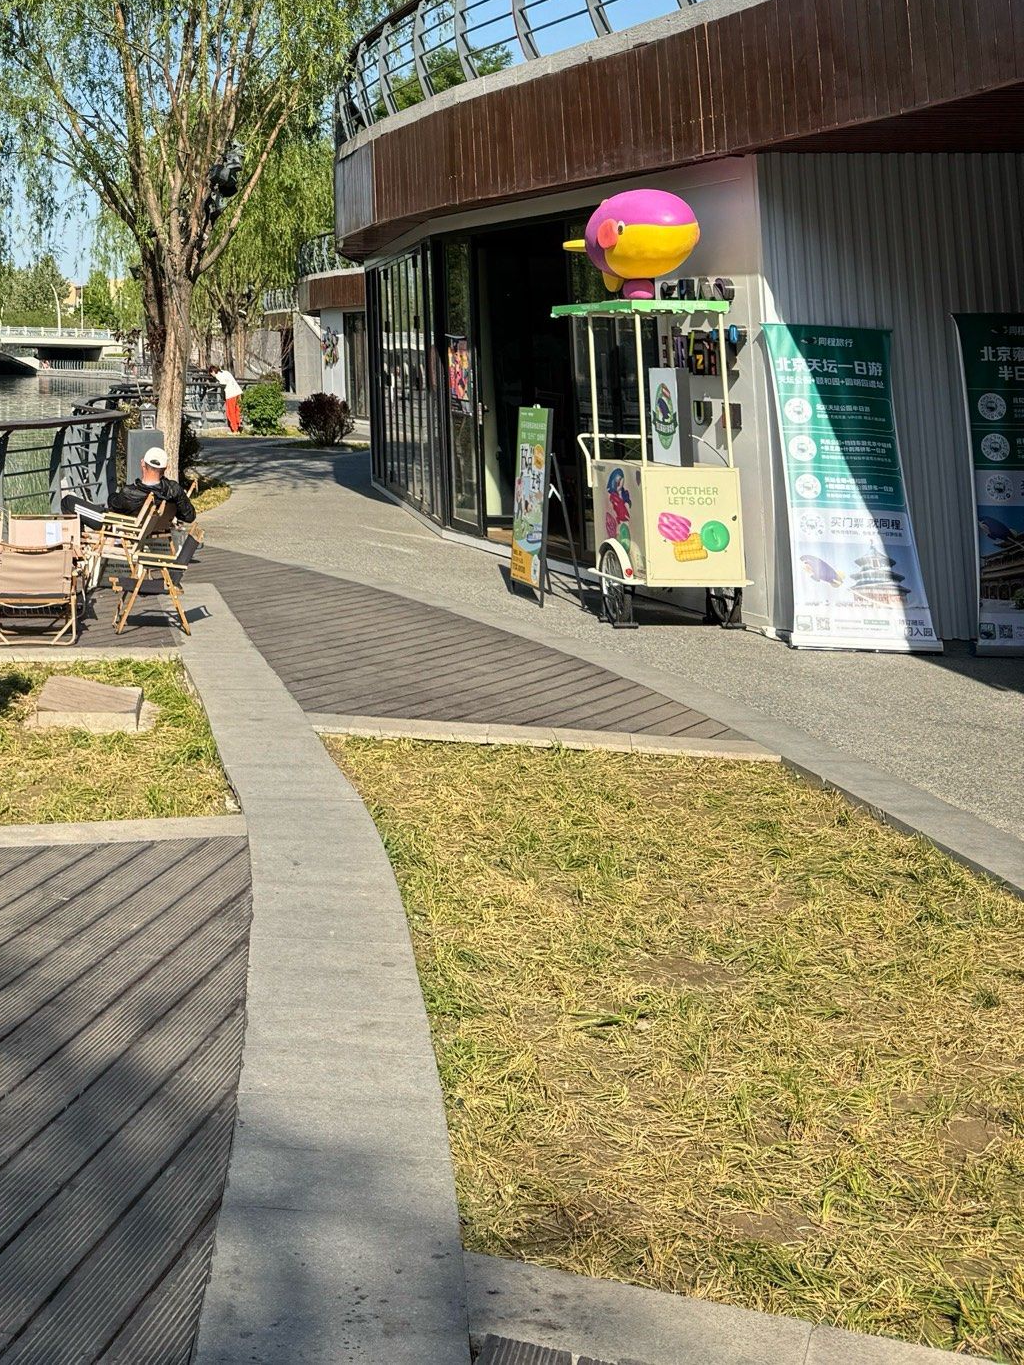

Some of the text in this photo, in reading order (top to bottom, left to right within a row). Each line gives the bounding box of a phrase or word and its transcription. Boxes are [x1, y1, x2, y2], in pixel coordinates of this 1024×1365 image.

[818, 337, 853, 347] 同程旅行
[776, 357, 883, 376] 北京天坛一日游
[665, 486, 719, 495] TOGETHER
[668, 497, 716, 506] LET'S GO!
[831, 516, 863, 528] 买门票
